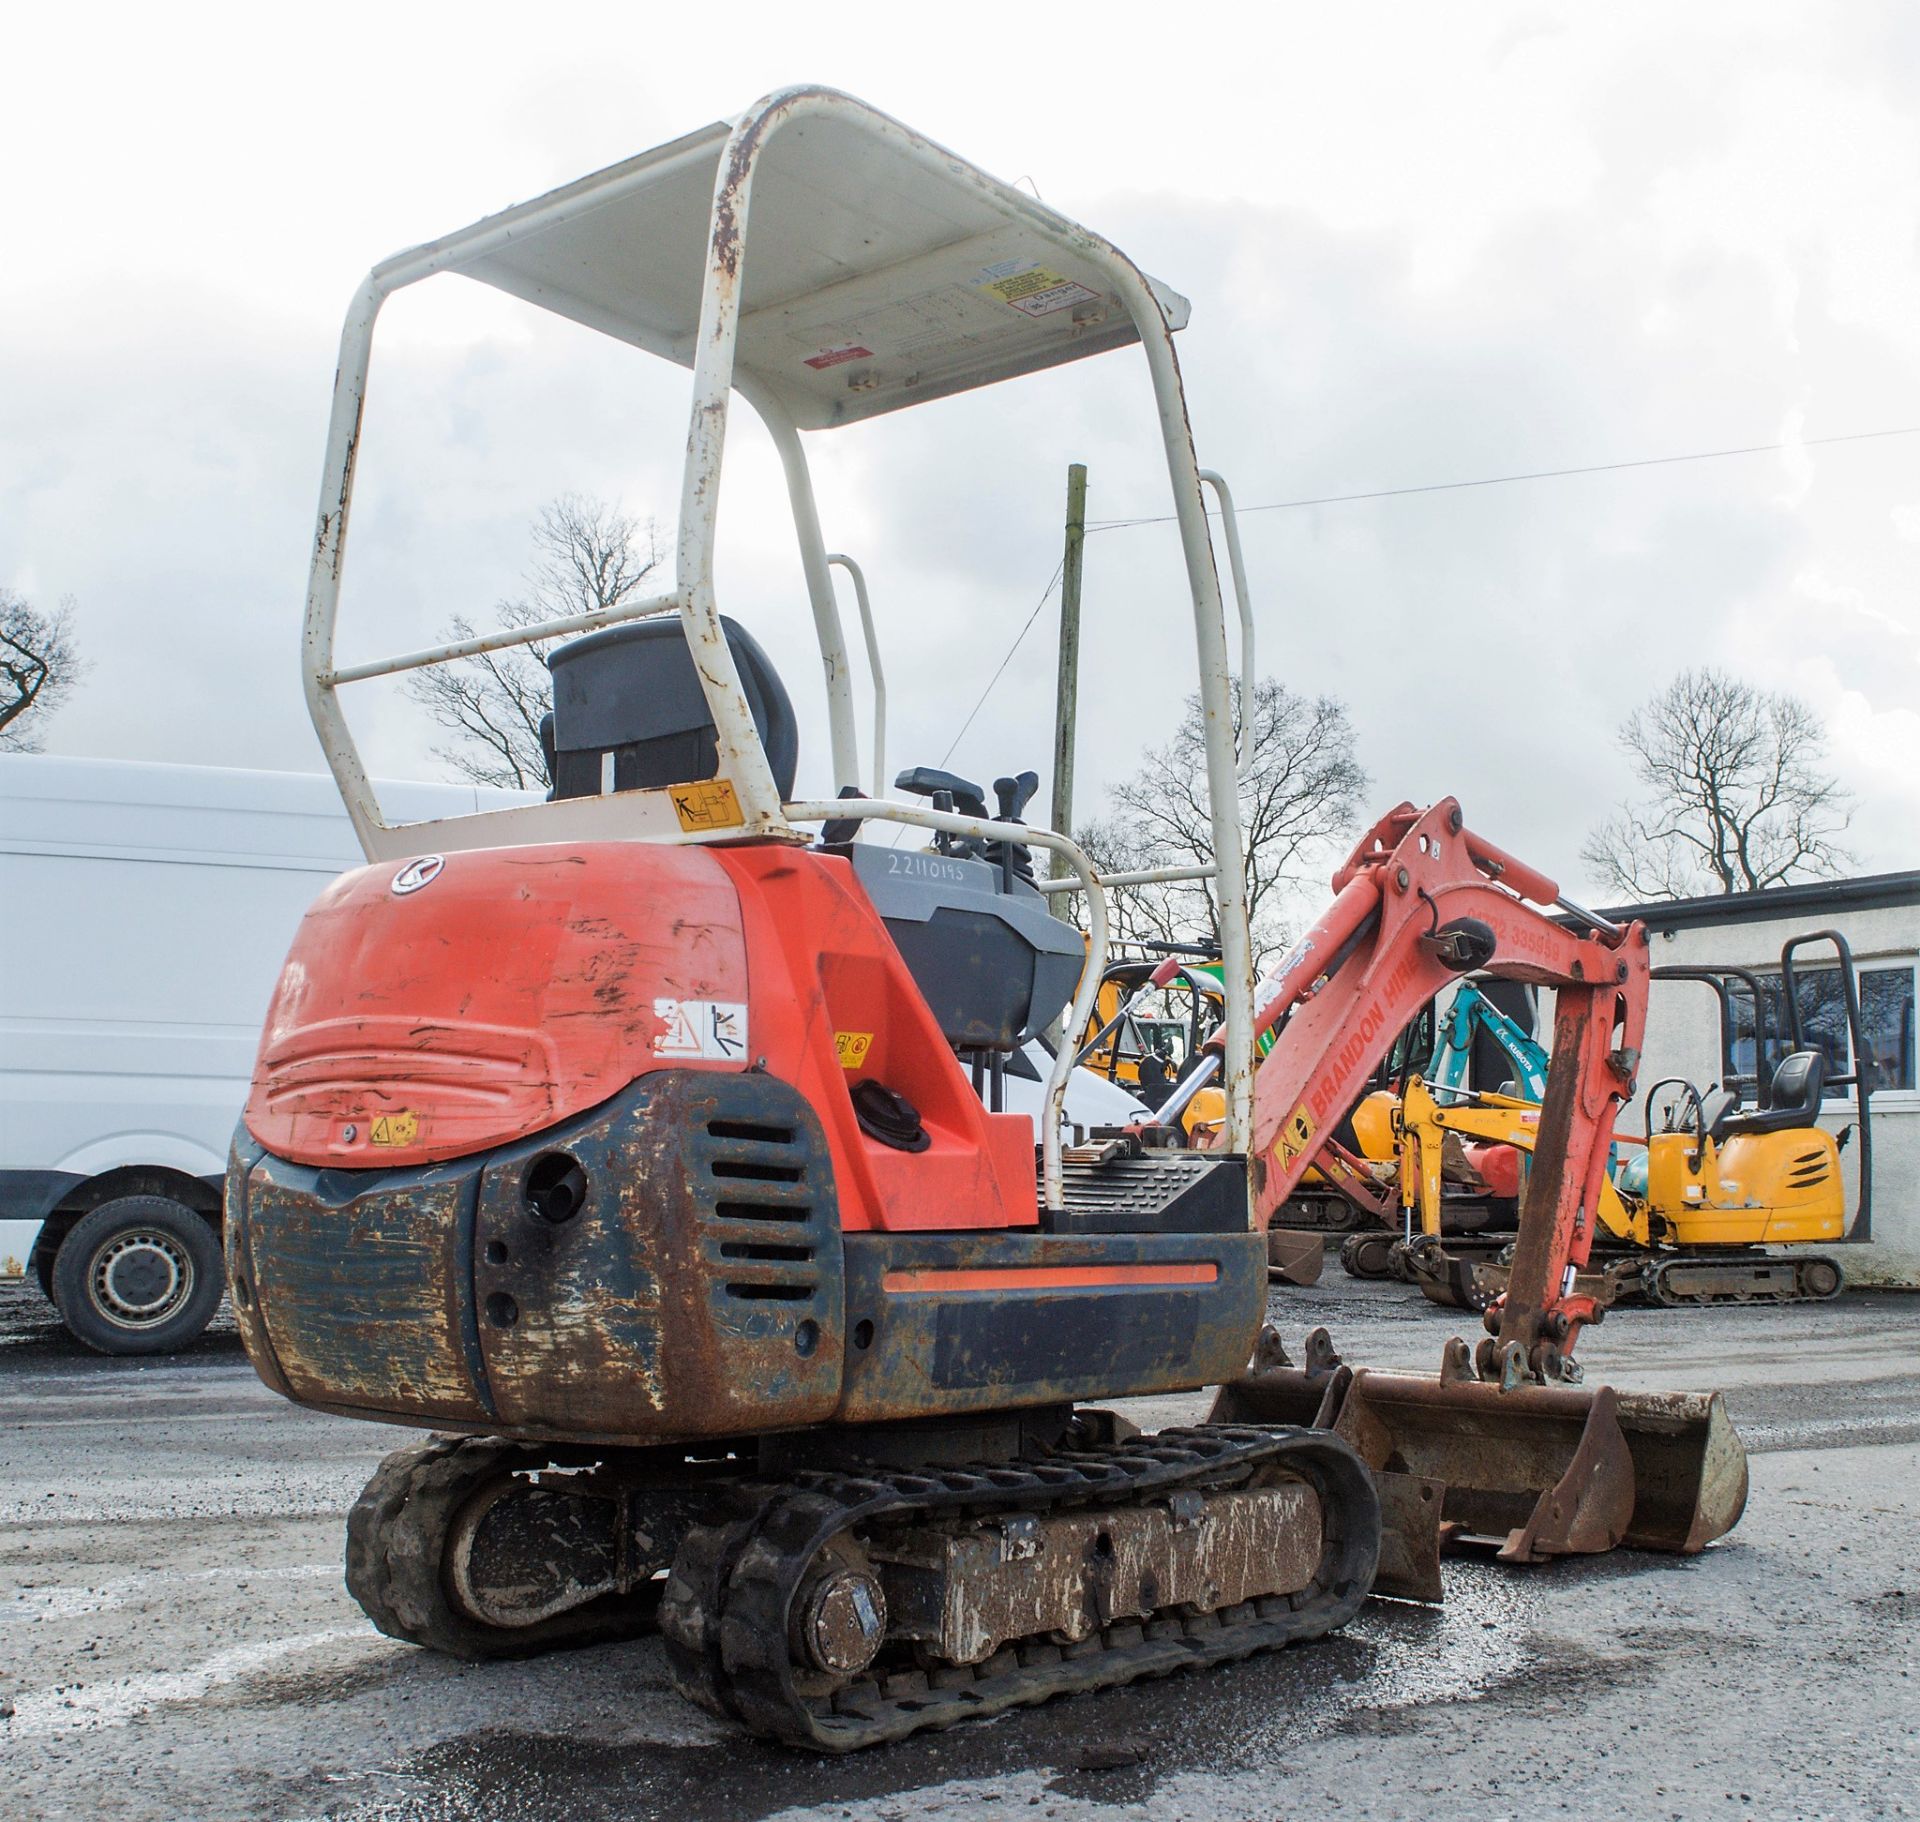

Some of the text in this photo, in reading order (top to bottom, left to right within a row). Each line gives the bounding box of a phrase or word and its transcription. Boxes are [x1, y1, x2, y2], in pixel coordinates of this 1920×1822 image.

[1033, 282, 1077, 301] Danger
[888, 854, 964, 881] 22110195
[1310, 1001, 1385, 1119] BRANDON
[1508, 1042, 1533, 1072] KUBOTA
